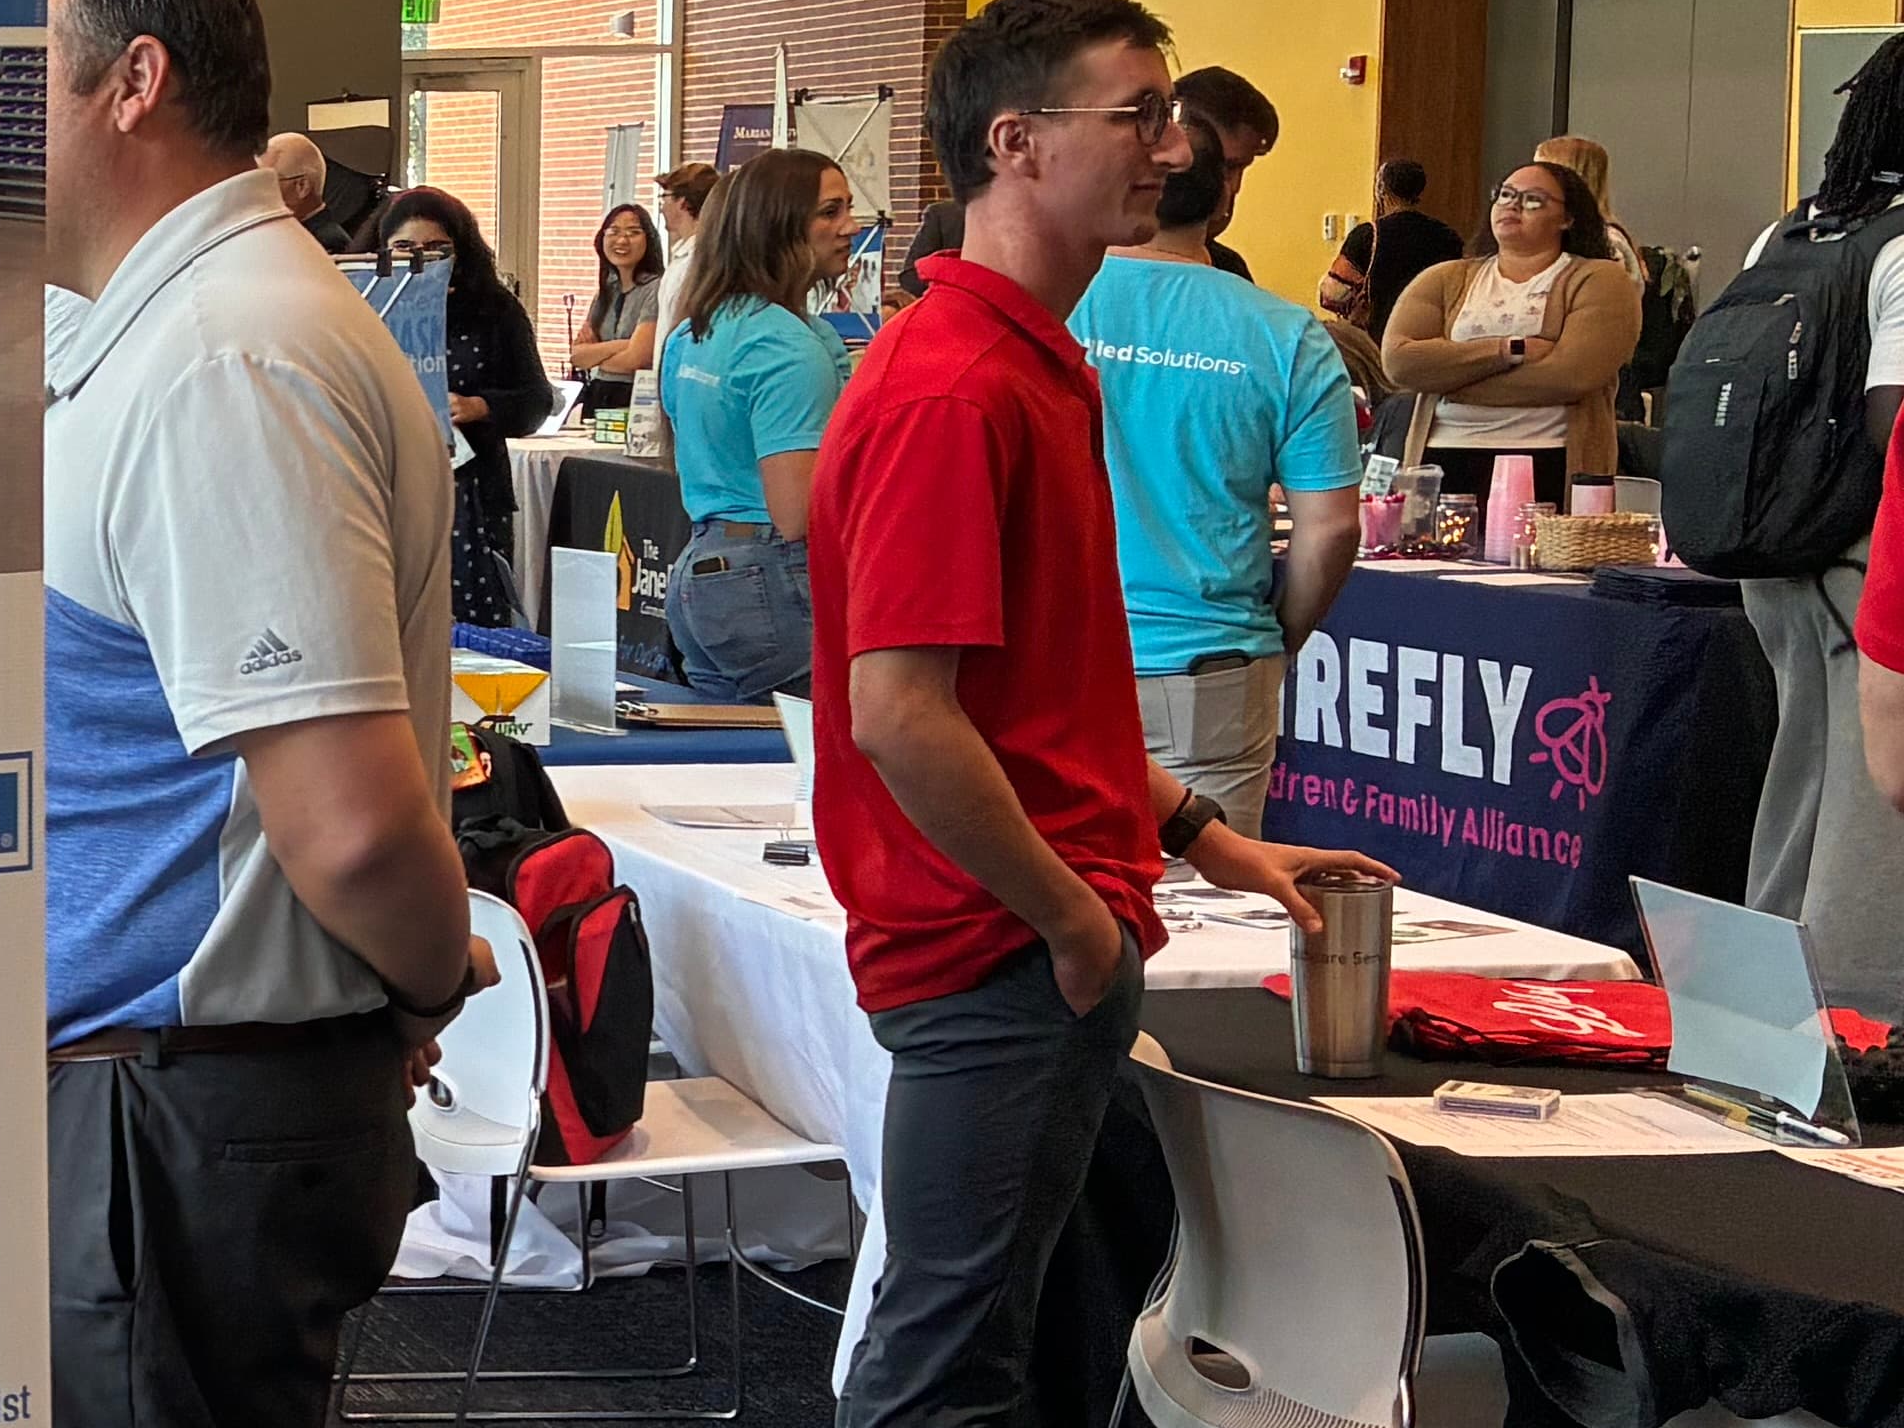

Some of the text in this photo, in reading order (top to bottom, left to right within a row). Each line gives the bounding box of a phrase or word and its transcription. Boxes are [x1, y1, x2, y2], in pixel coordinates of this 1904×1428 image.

[240, 649, 303, 674] adidas
[1277, 629, 1533, 785] REFLY
[1269, 762, 1583, 869] dren & Family Alliance
